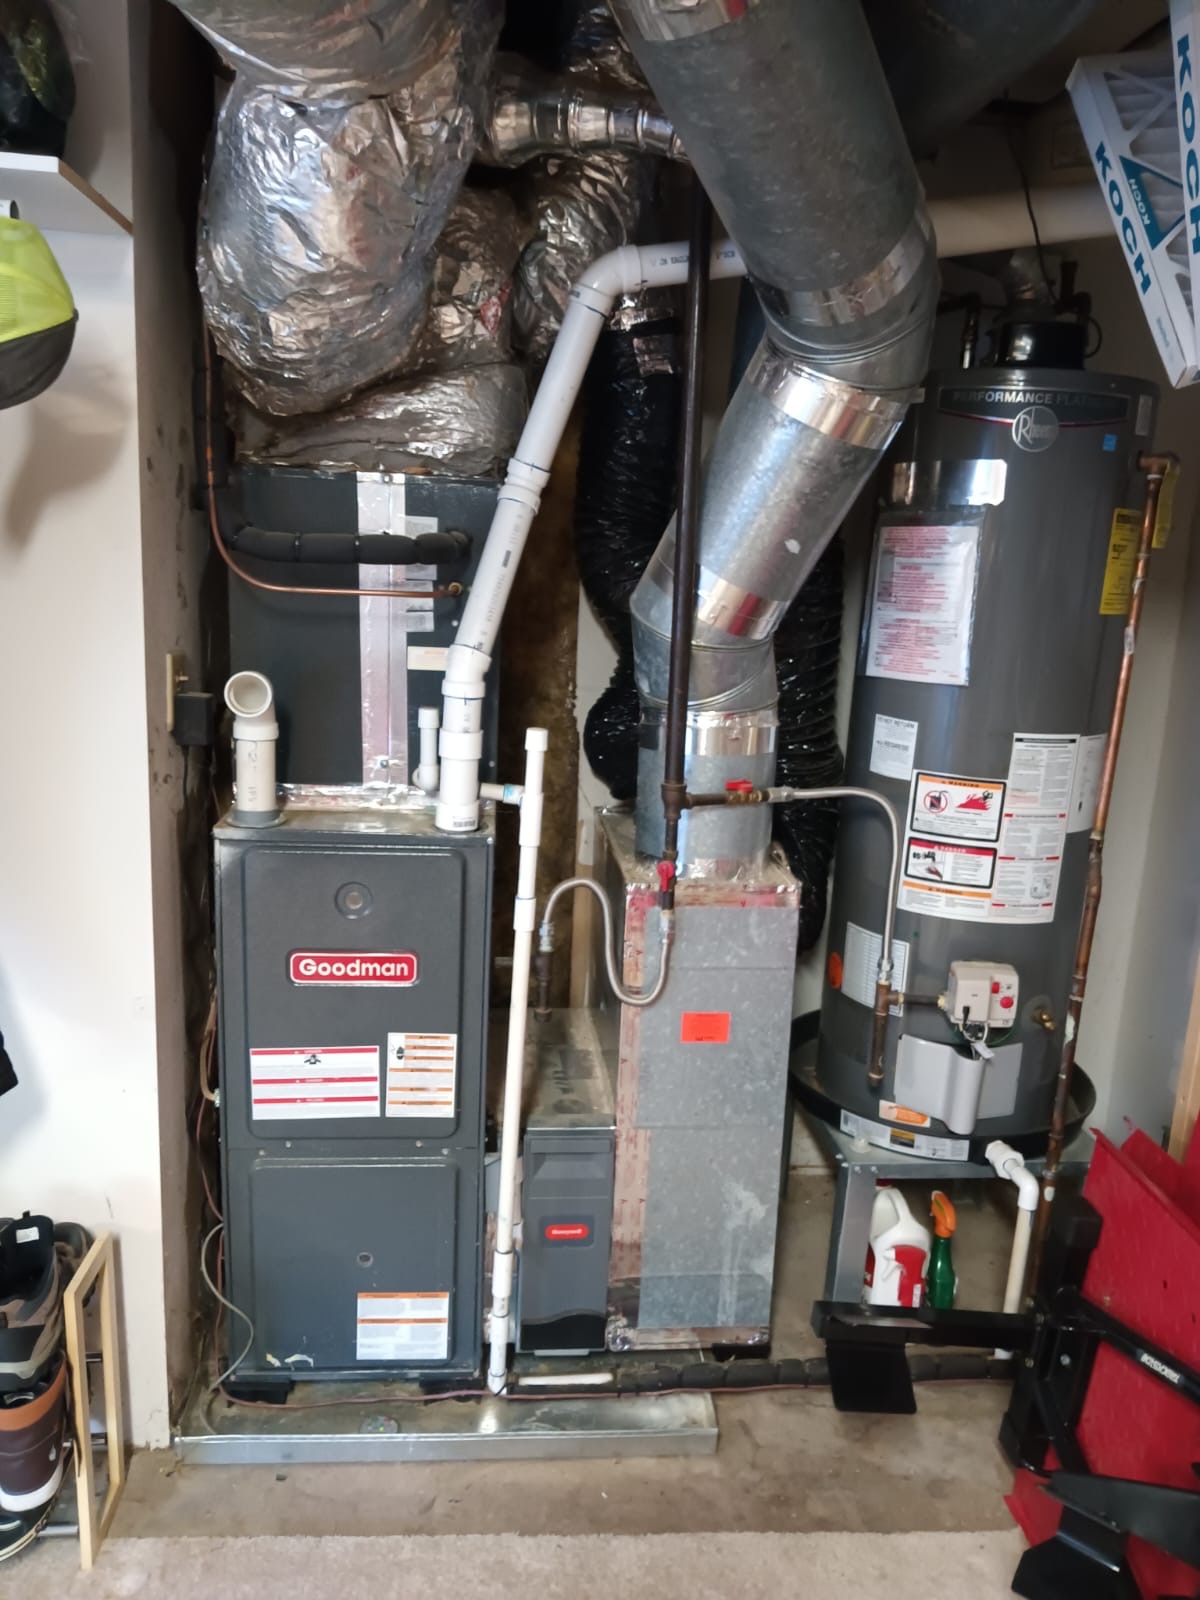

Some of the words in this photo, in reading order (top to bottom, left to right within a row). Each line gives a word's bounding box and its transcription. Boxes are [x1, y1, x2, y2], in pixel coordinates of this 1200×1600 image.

[1176, 33, 1200, 255] KOCH
[1095, 141, 1152, 295] KOCH
[1128, 178, 1151, 225] KOCH
[952, 390, 1053, 405] PERFORMANCE
[298, 958, 409, 977] Goodman
